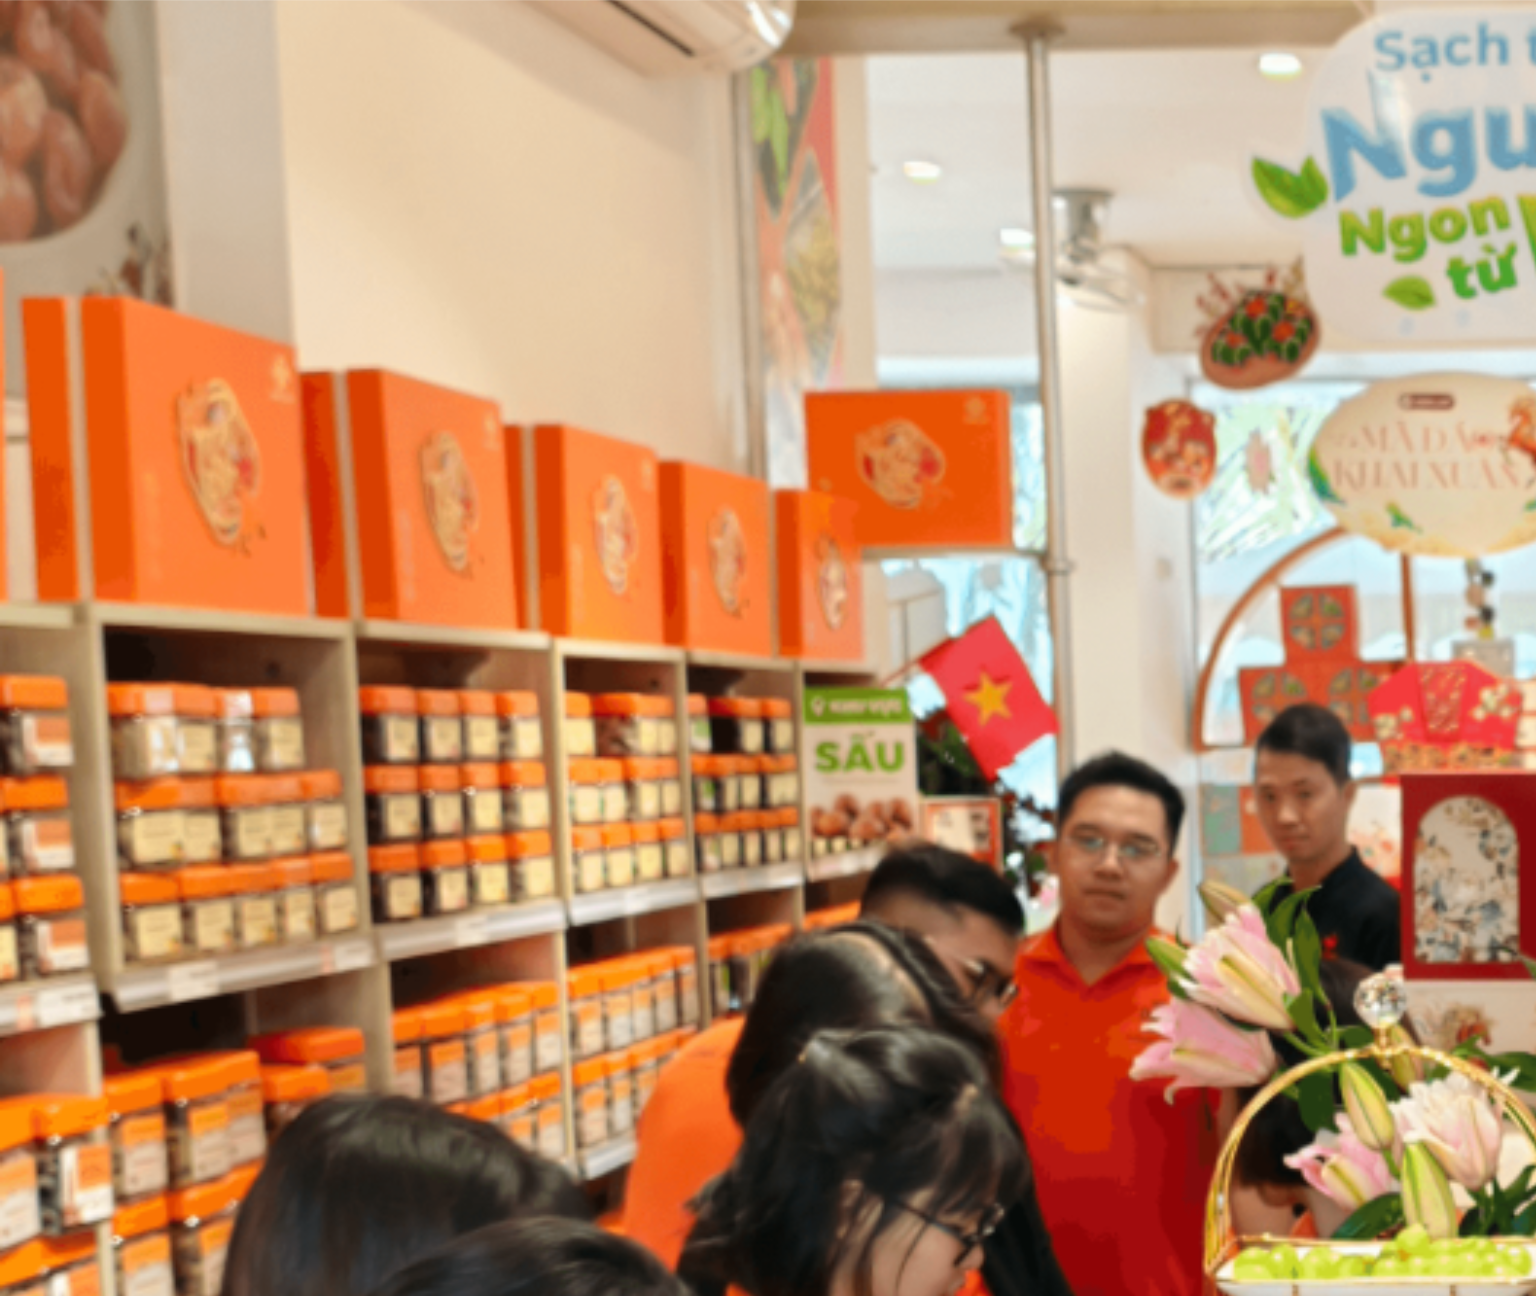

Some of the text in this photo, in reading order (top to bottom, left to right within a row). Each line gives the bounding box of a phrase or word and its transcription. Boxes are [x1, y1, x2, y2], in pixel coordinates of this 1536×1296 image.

[1374, 22, 1509, 83] Sạch
[1338, 193, 1511, 264] Ngon
[1446, 240, 1518, 300] từ
[814, 730, 906, 775] SẤU
